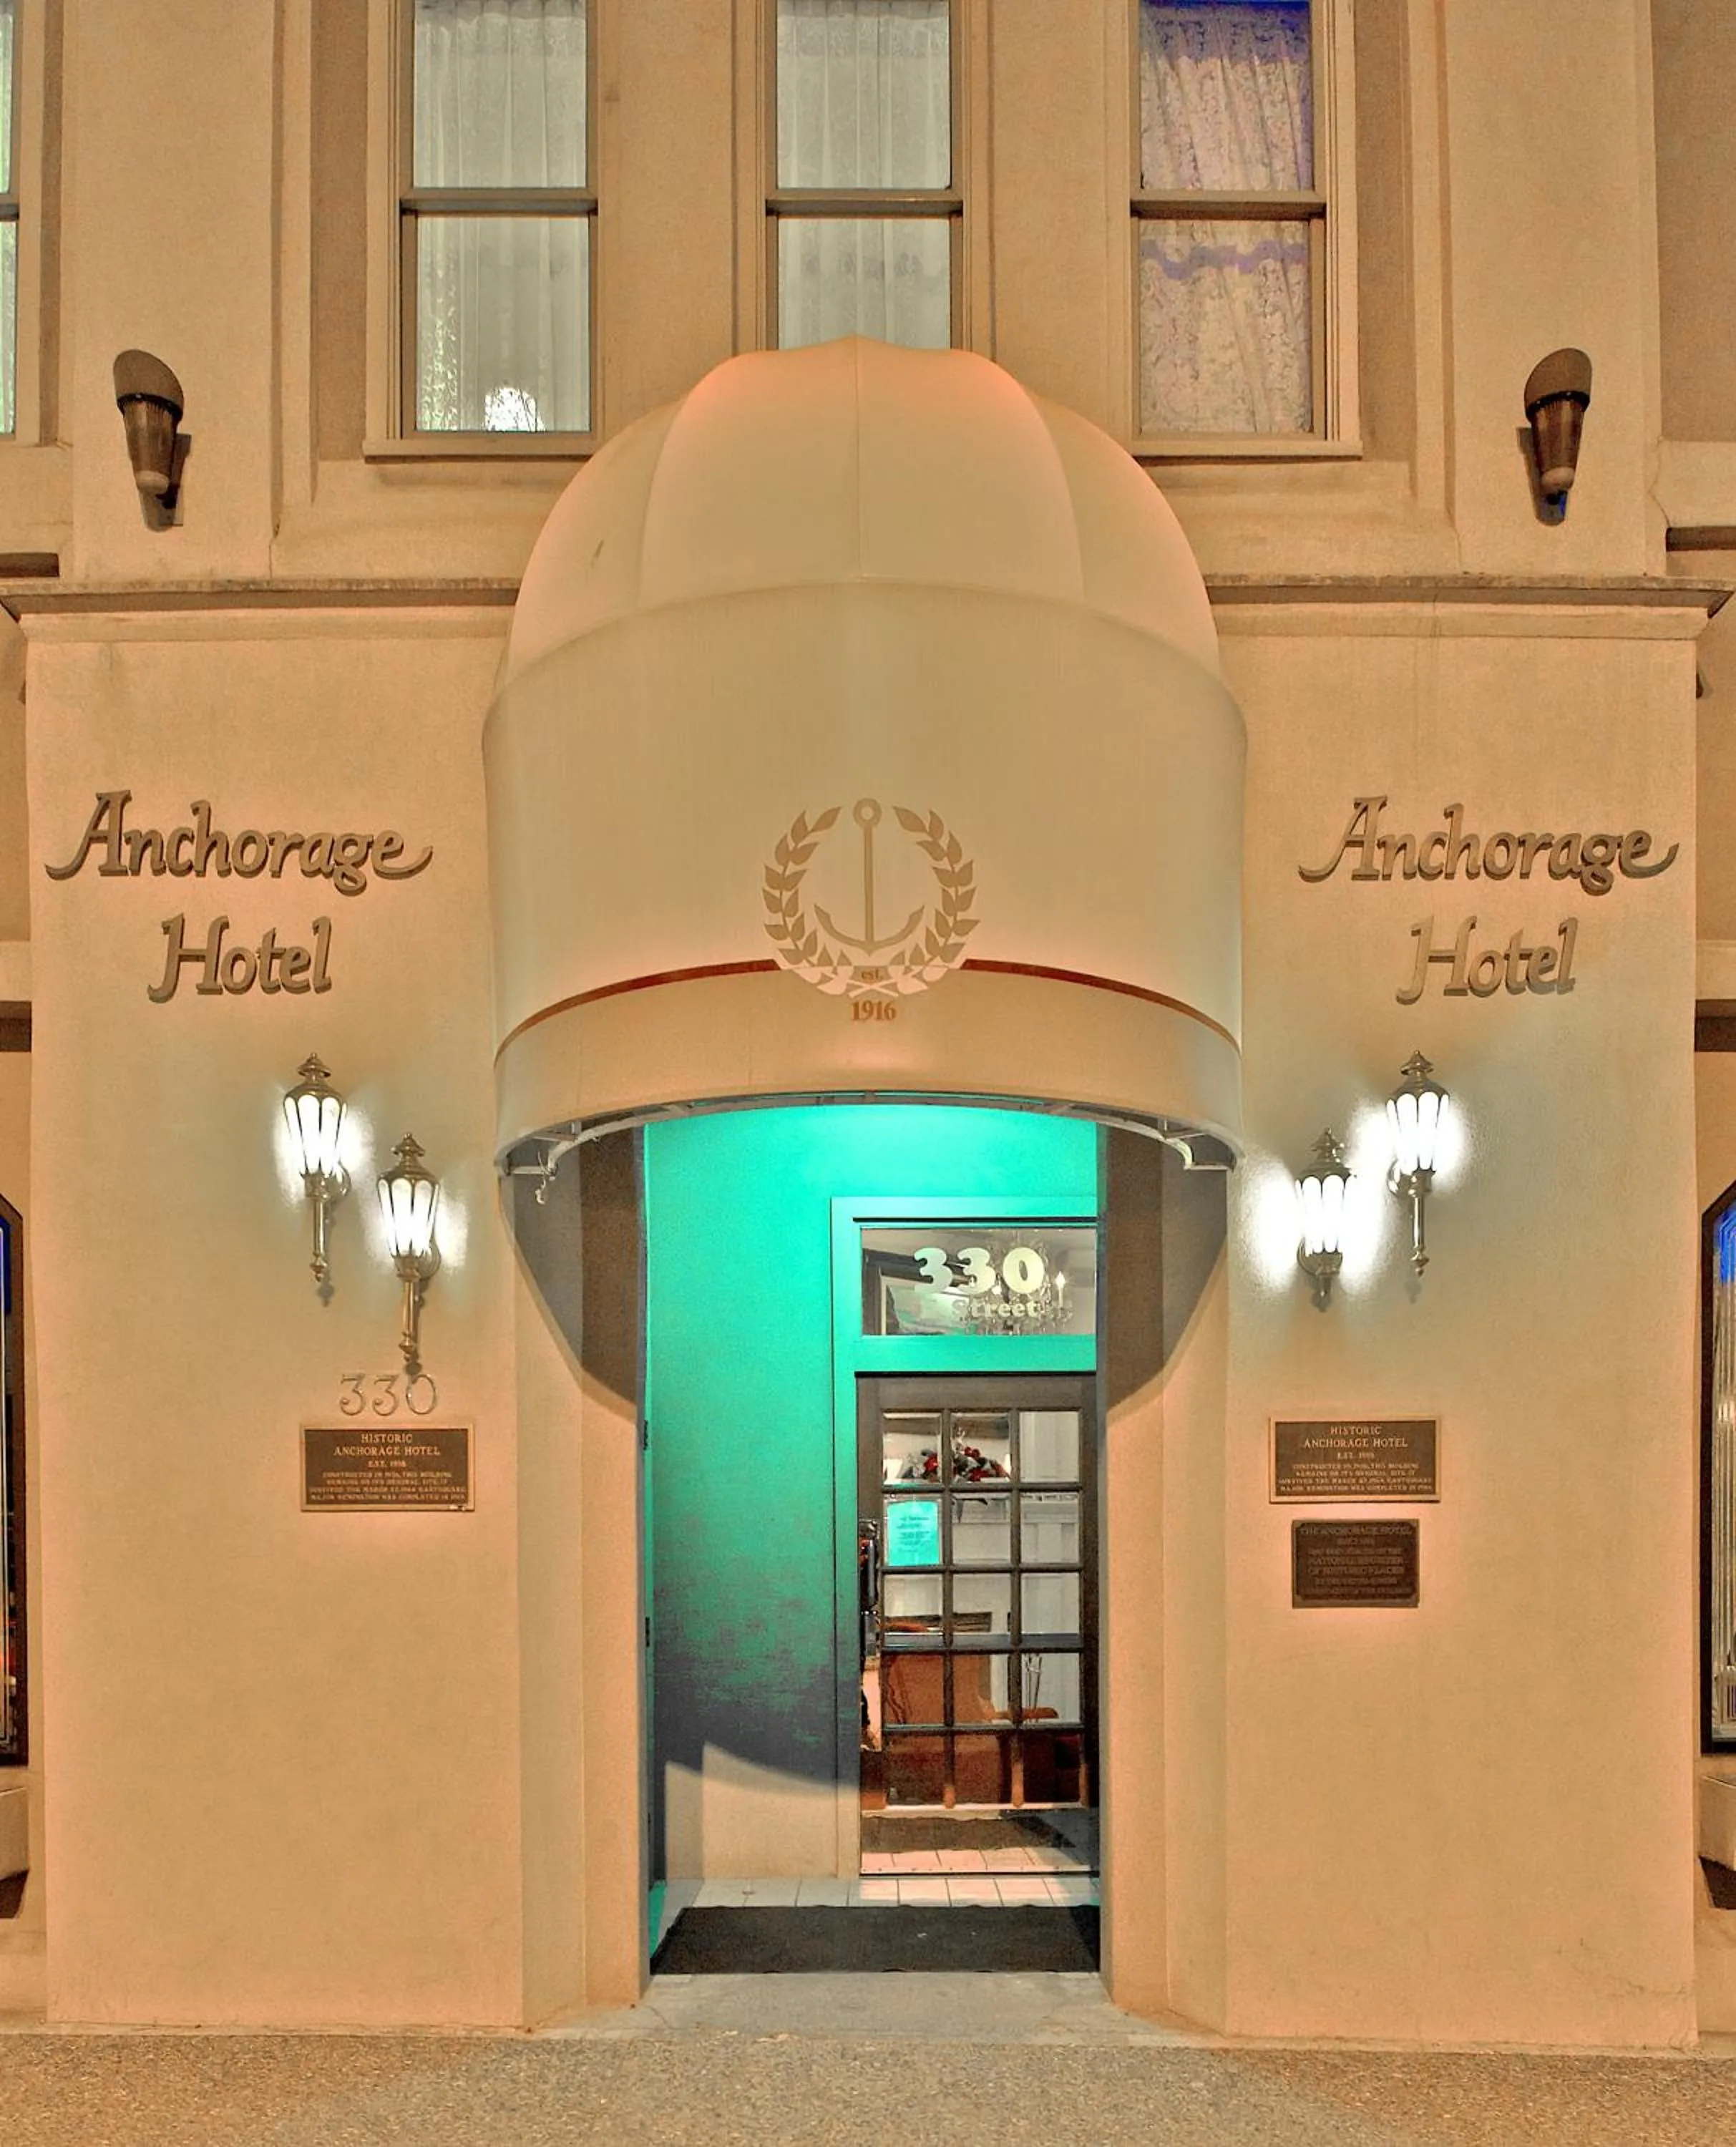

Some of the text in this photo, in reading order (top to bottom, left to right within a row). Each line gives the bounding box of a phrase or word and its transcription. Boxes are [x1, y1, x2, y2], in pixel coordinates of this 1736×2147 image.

[45, 789, 433, 896] Anchorage
[1297, 795, 1679, 896] Anchorage
[147, 913, 332, 1003] Hotel
[1395, 915, 1578, 1005] Hotel
[861, 968, 883, 980] est.
[851, 1001, 897, 1021] 1916
[914, 1247, 1045, 1294] 330
[952, 1298, 1040, 1319] Street
[339, 1373, 439, 1416] 330
[361, 1433, 413, 1443] HISTORIC
[1330, 1425, 1383, 1435] HISTORIC
[333, 1445, 441, 1456] ANCHORAGE HOTEL
[1304, 1437, 1409, 1449] ANCHORAGE HOTEL
